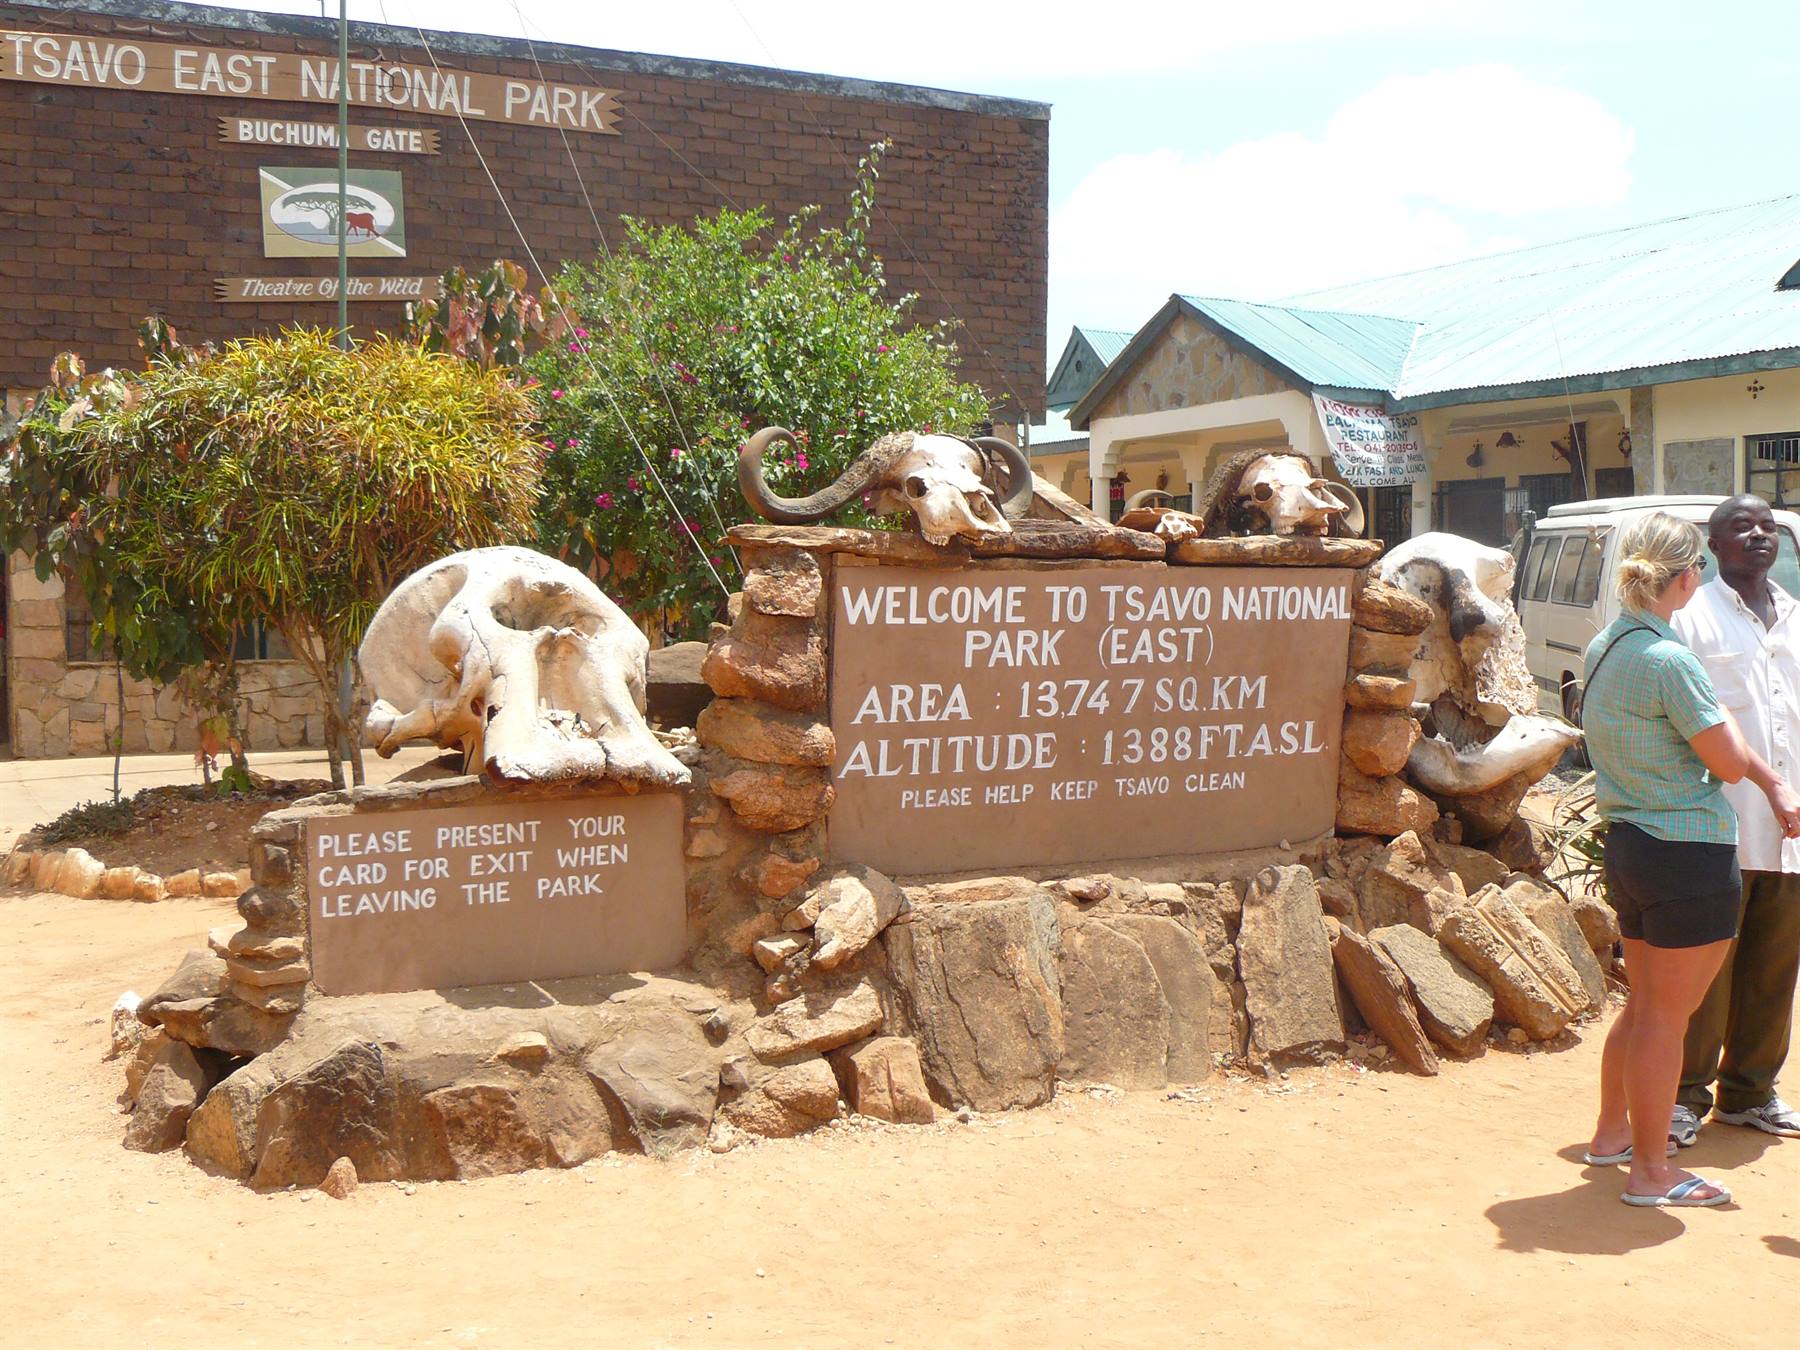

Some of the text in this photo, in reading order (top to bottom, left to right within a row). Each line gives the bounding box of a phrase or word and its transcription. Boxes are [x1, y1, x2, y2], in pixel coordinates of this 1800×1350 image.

[6, 34, 606, 130] TSAVO EAST NATIONAL PARK
[366, 128, 423, 152] GATE
[241, 278, 314, 297] Theatre
[346, 279, 374, 295] the
[379, 277, 424, 296] Wild
[1341, 429, 1408, 442] RESTAURANT
[842, 585, 1351, 625] WELCOME TO TSAVO NATIONAL
[964, 624, 1214, 669] PARK (EAST)
[849, 682, 973, 725] AREA
[1153, 675, 1269, 713] SQ.KM
[836, 731, 1058, 779] ALTITUDE
[901, 771, 1246, 809] PLEASE HELP KEEP TSAVO CLEAN
[318, 815, 626, 858] PLEASE PRESENT YOUR
[318, 844, 629, 888] CARD FOR EXIT WHEN
[321, 873, 604, 918] LEAVING THE PARK
